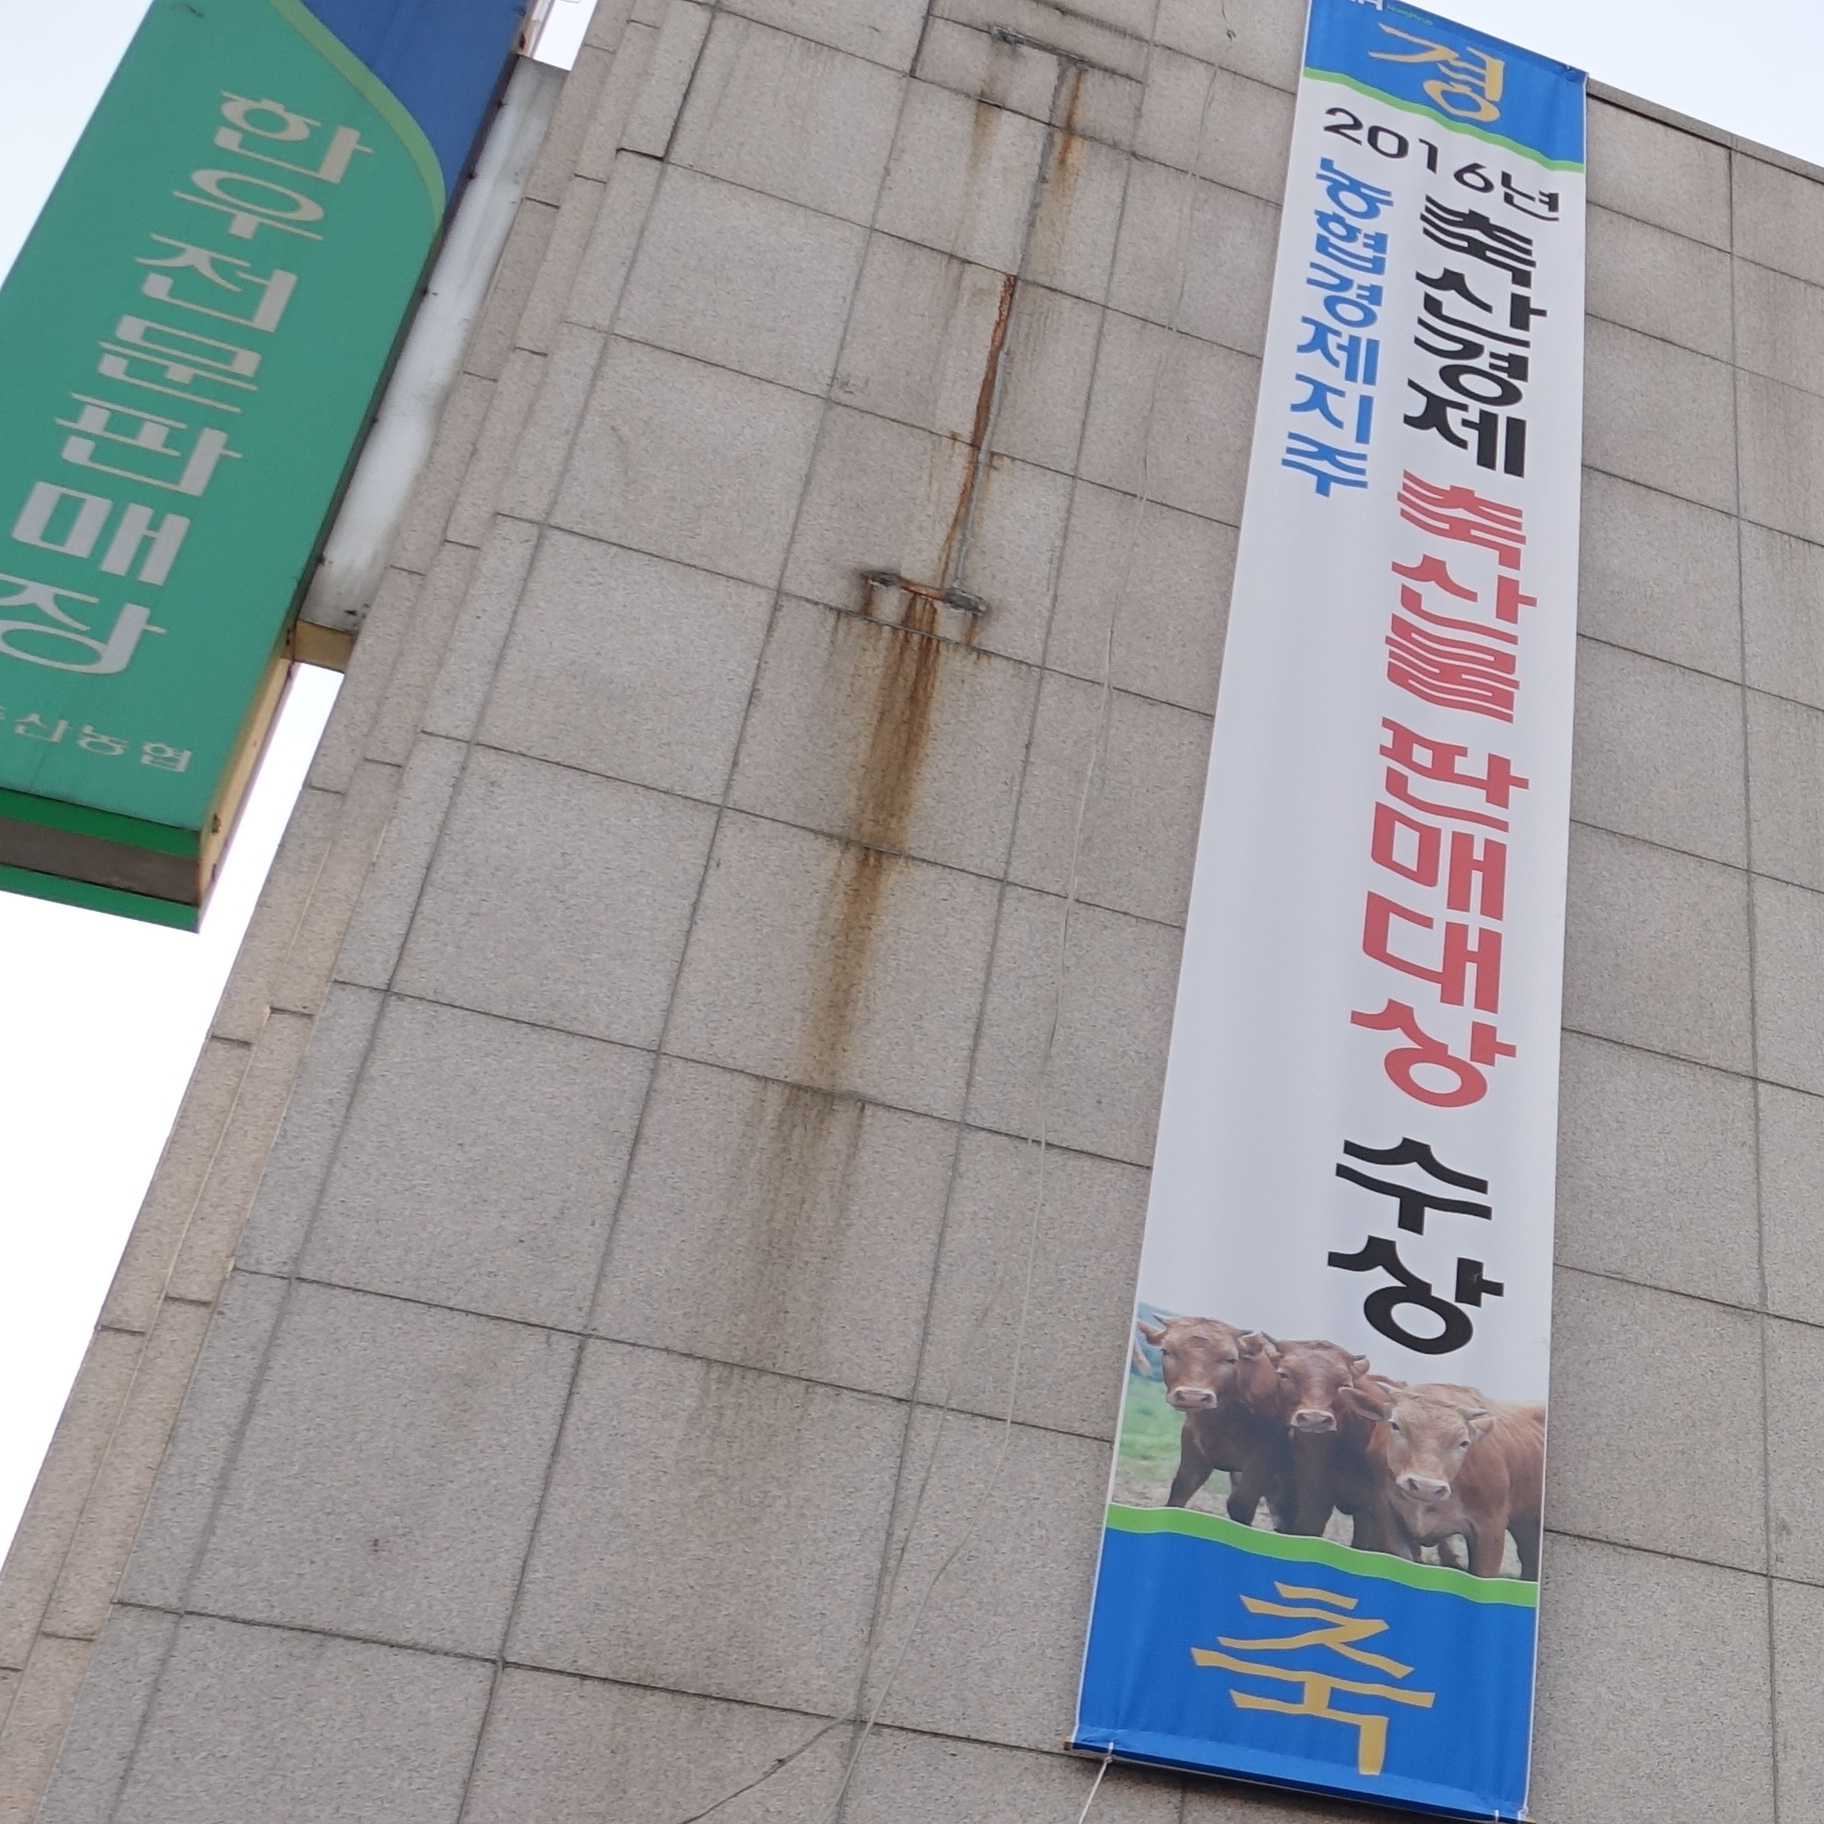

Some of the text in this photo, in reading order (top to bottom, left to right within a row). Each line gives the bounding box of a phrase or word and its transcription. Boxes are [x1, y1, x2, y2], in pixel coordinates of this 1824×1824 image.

[1323, 107, 1560, 222] 2016년
[1368, 21, 1505, 122] 경
[0, 89, 372, 677] 한우전문판매장
[1281, 157, 1393, 499] 농협경제지주
[1404, 194, 1547, 478] 축산경제
[1384, 468, 1537, 723] 축산물
[0, 706, 192, 773] 산농협
[1327, 1136, 1503, 1354] 수상
[1189, 1580, 1434, 1776] 축
